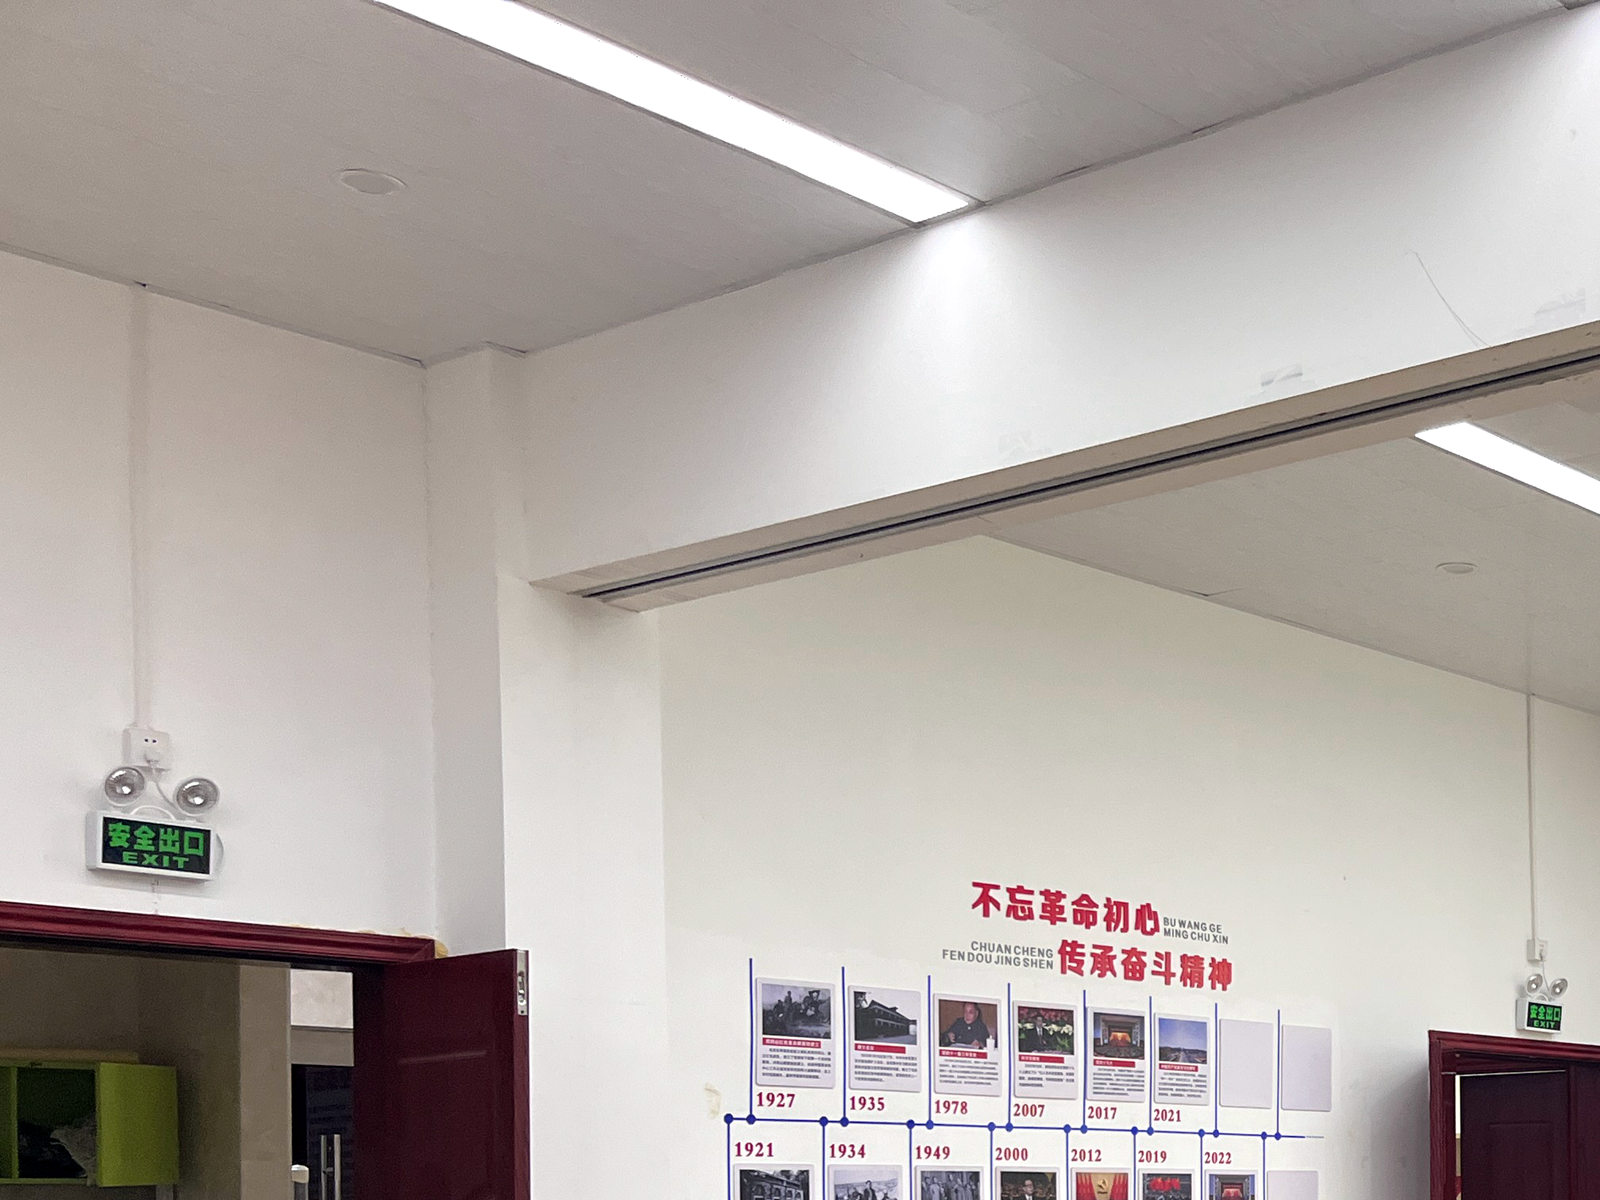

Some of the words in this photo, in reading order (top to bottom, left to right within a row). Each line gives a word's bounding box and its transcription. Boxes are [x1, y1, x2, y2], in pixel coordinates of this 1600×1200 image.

[107, 821, 205, 857] 安全出口
[122, 850, 190, 869] EXIT
[971, 881, 1160, 936] 不忘革命初心
[1163, 916, 1177, 928] BU
[1178, 919, 1208, 932] WANG
[1208, 923, 1222, 934] GE
[1163, 928, 1189, 940] MING
[1190, 931, 1210, 943] CHU
[1212, 934, 1229, 944] XIN
[970, 940, 1012, 955] CHUAN
[1013, 945, 1054, 959] CHENG
[942, 949, 966, 962] FEN
[967, 952, 993, 964] DOU
[994, 955, 1021, 967] JING
[1022, 957, 1054, 970] SHEN
[1058, 939, 1233, 992] 传承奋斗精神
[1533, 1020, 1556, 1029] EXIT
[756, 1091, 796, 1108] 1927
[849, 1096, 885, 1111] 1935
[934, 1099, 968, 1115] 1978
[1013, 1103, 1045, 1118] 2007
[1088, 1106, 1117, 1119] 2017
[1154, 1109, 1182, 1122] 2021
[735, 1142, 775, 1157] 1921
[829, 1143, 866, 1159] 1934
[915, 1145, 951, 1160] 1949
[995, 1147, 1029, 1161] 2000
[1071, 1149, 1102, 1162] 2012
[1138, 1150, 1167, 1163] 2019
[1204, 1152, 1232, 1165] 2022
